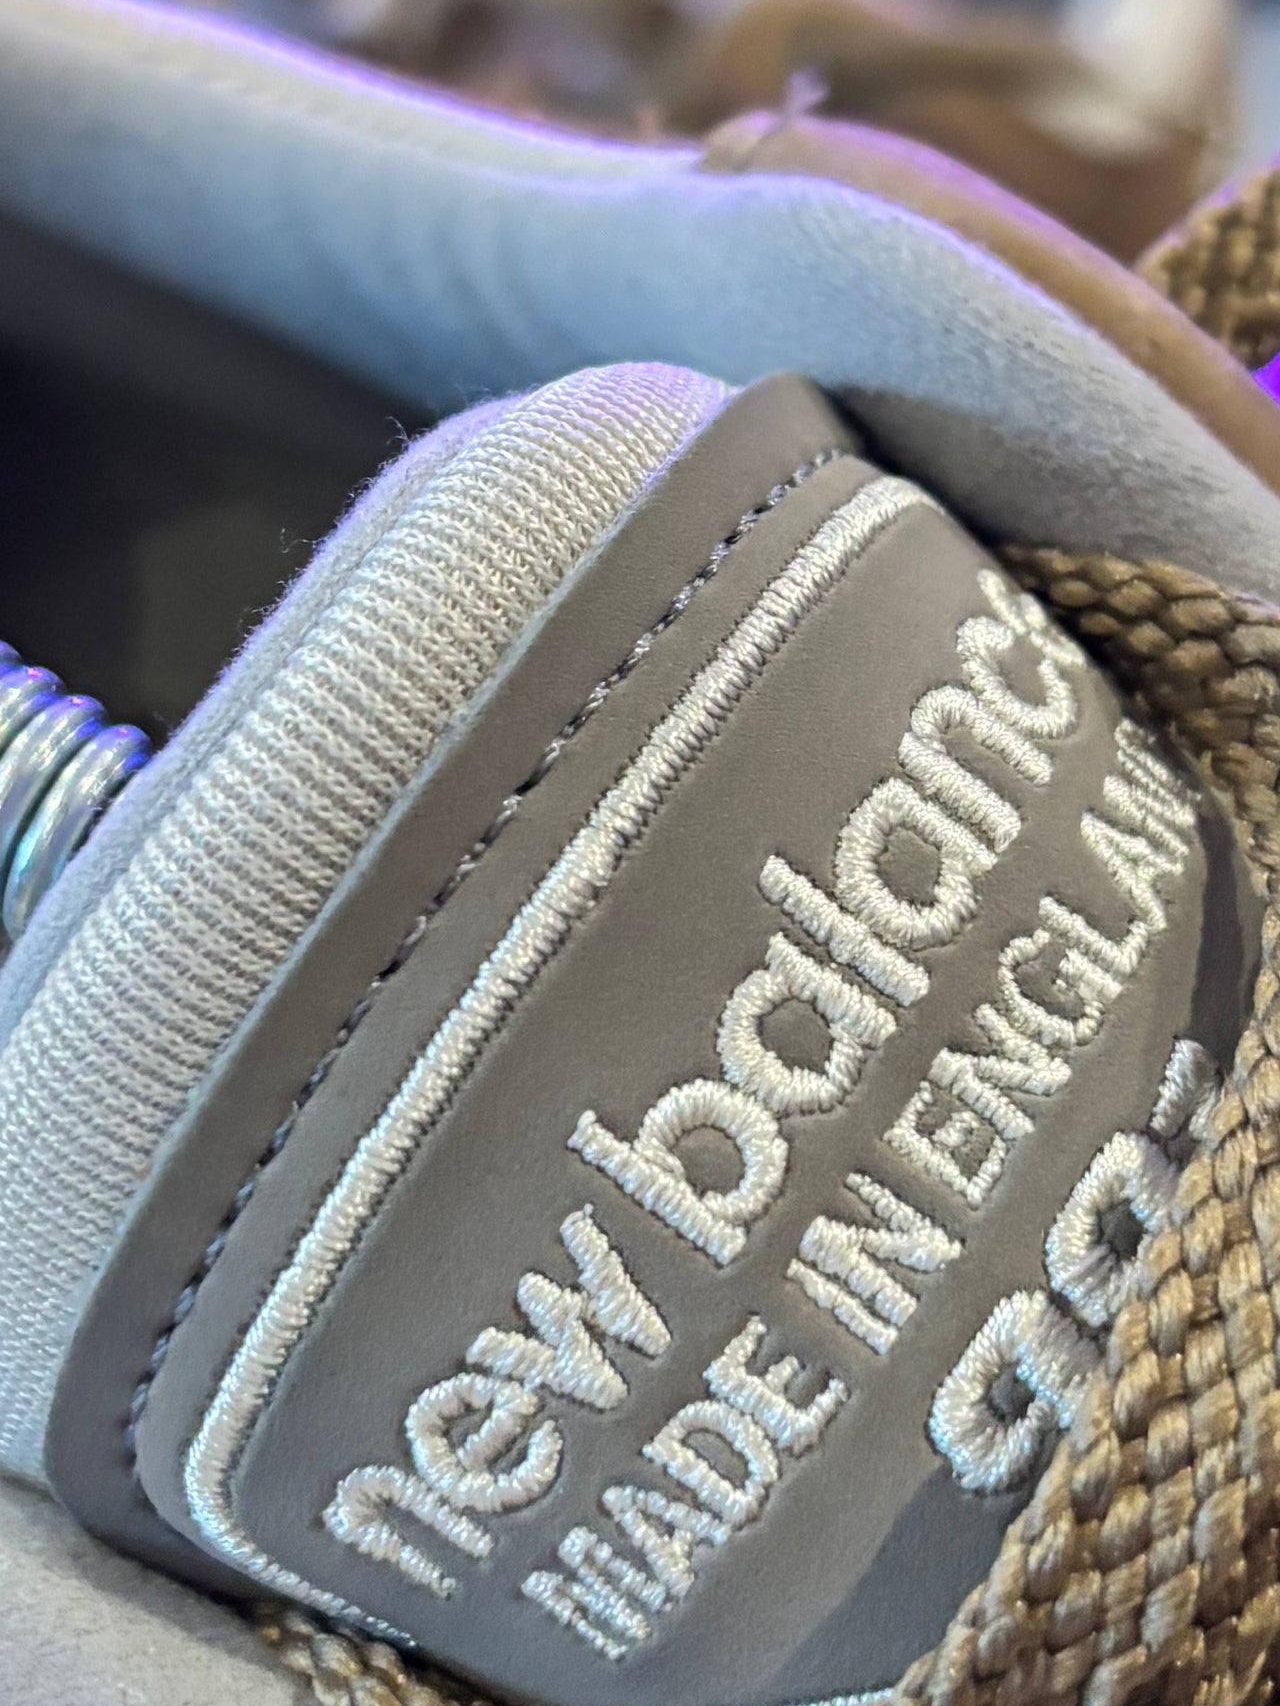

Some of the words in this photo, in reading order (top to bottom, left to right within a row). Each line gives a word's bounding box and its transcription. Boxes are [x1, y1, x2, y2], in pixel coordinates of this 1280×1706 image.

[322, 1204, 672, 1597] new
[520, 1314, 848, 1662] MADE
[786, 1172, 963, 1355] IN
